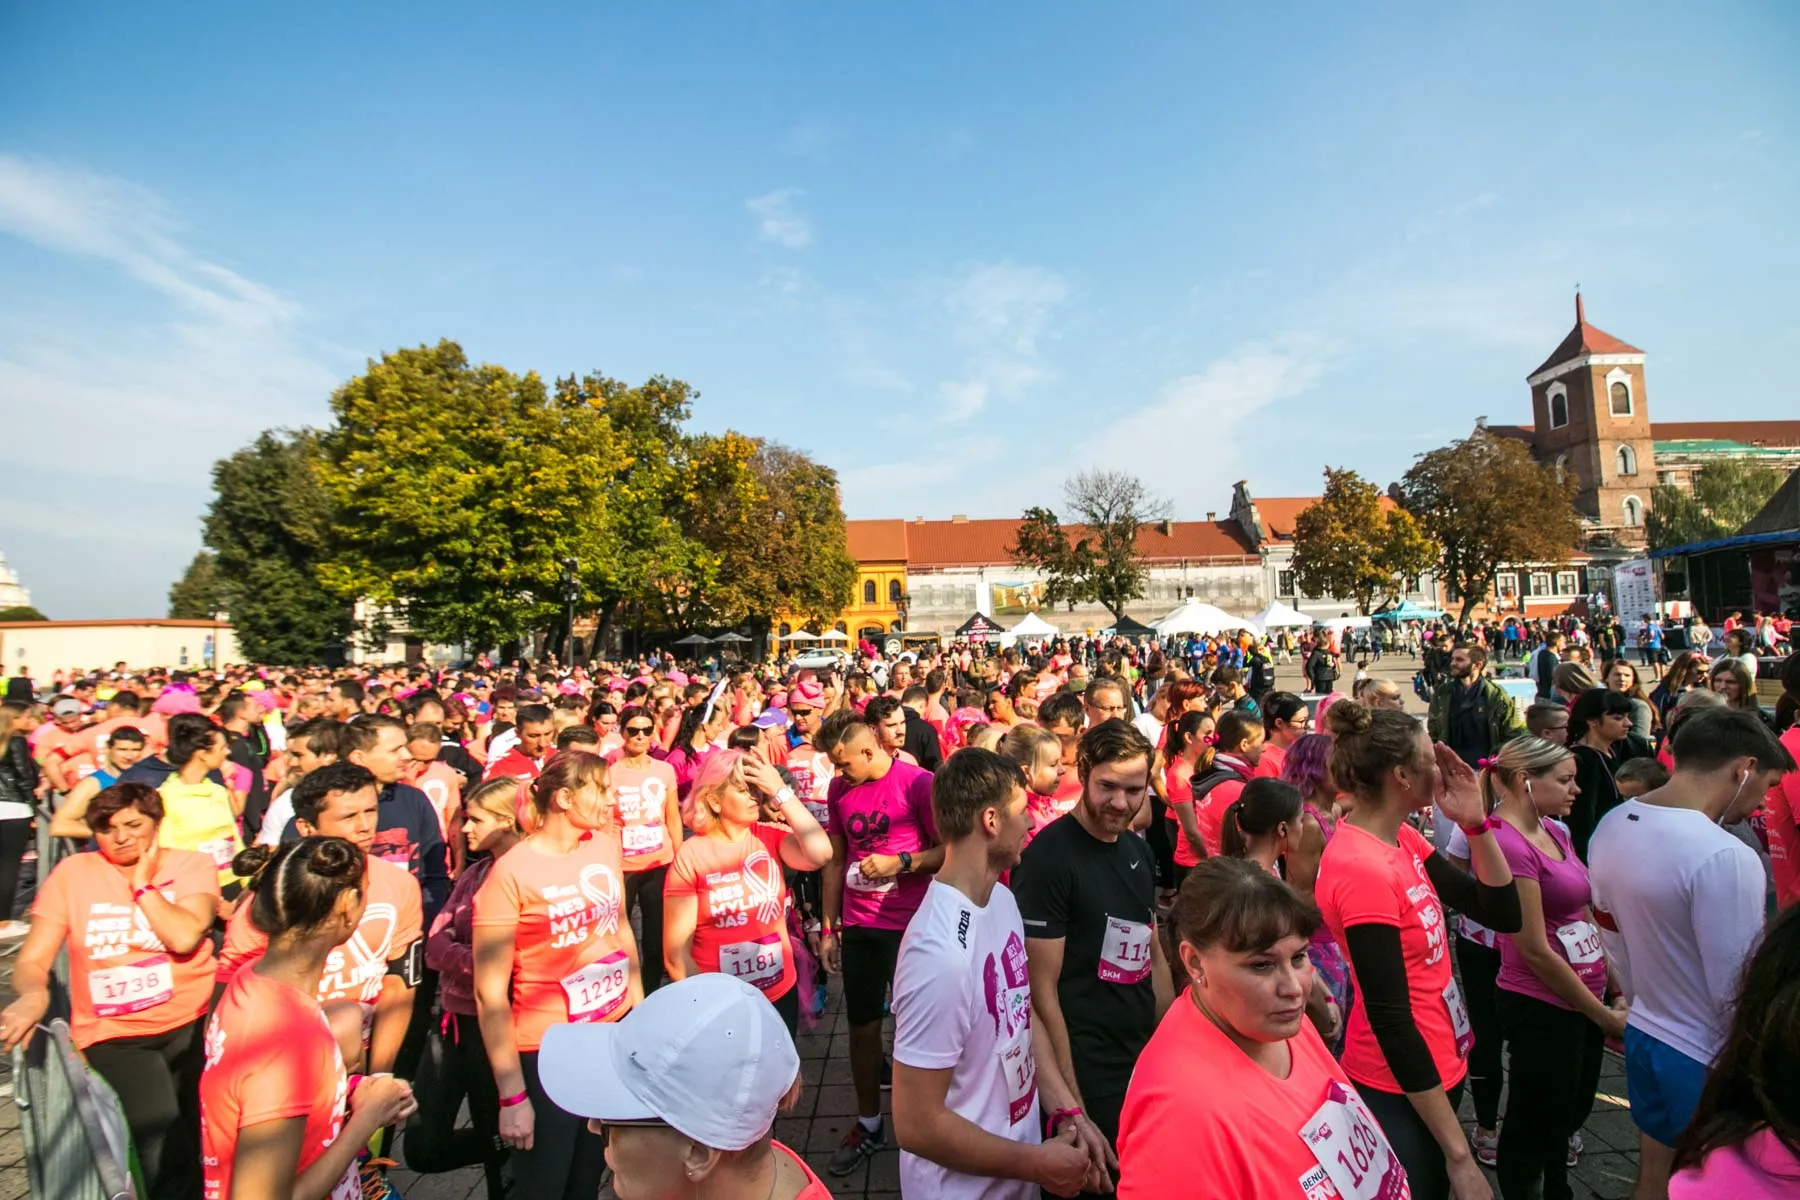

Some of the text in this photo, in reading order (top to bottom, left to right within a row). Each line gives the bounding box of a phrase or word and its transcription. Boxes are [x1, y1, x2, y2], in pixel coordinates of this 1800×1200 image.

[793, 769, 811, 779] ES
[797, 789, 813, 799] AS
[709, 884, 745, 904] NES
[547, 897, 586, 920] NES
[87, 916, 131, 933] NES
[715, 911, 749, 929] JAS
[551, 926, 588, 949] JAS
[88, 944, 129, 960] JAS
[731, 951, 777, 977] 1181
[1102, 969, 1121, 980] 5KM
[103, 972, 160, 999] 1738
[580, 969, 625, 1007] 1228
[1013, 1102, 1028, 1120] 5KM
